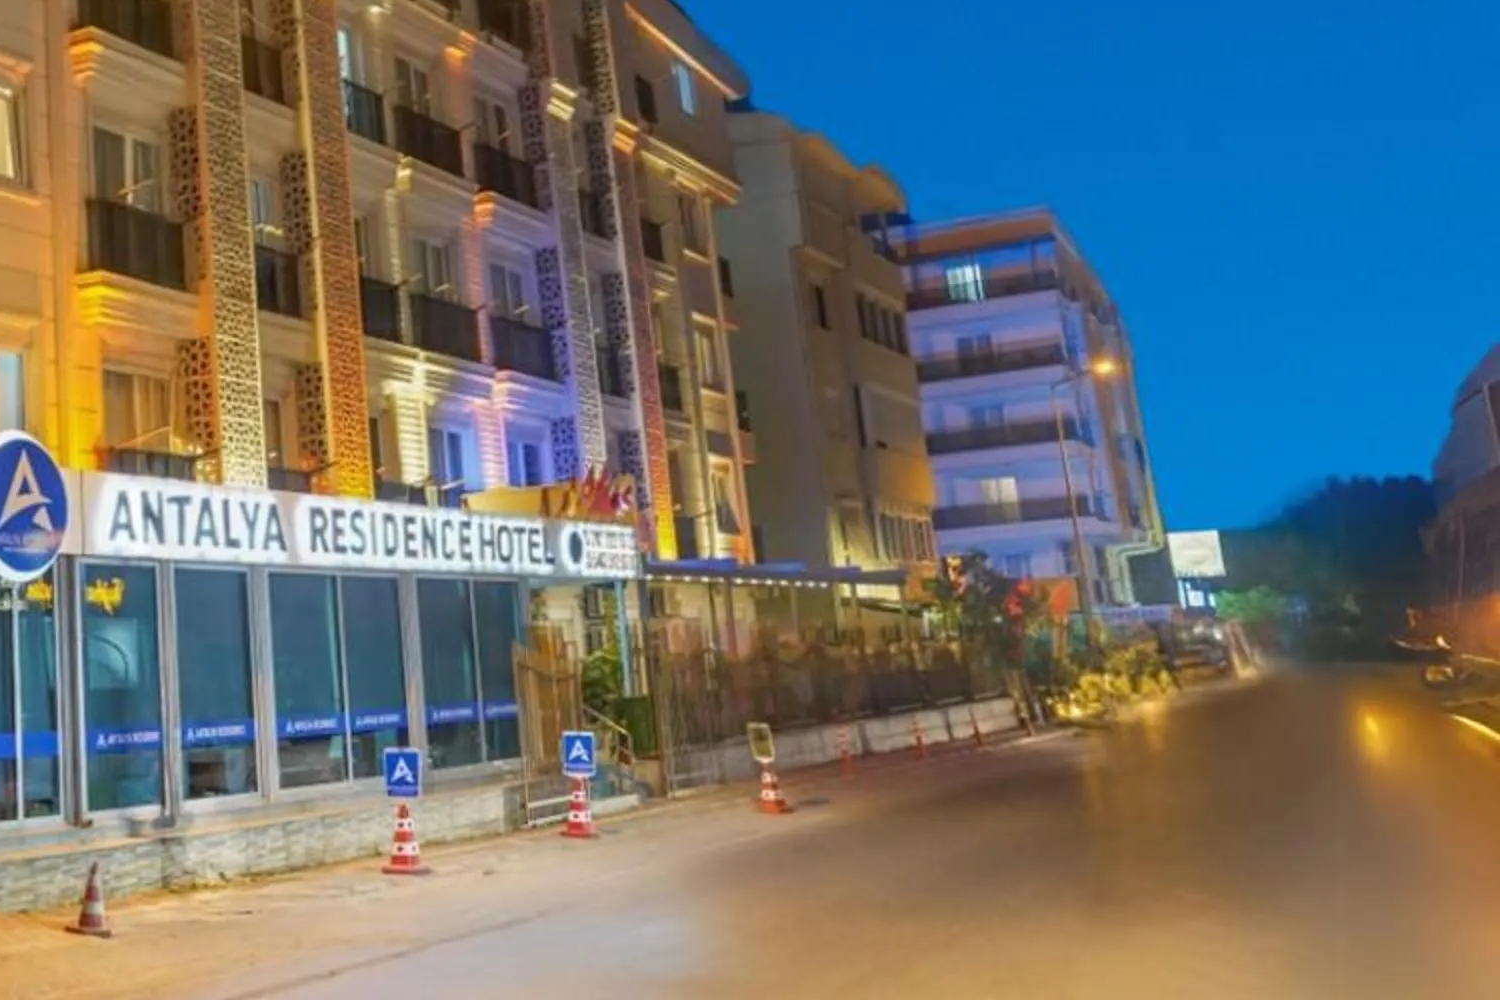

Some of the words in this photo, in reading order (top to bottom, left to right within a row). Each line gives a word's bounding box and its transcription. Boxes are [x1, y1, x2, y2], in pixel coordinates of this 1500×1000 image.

[109, 490, 287, 552] ANTALYA
[309, 507, 473, 561] RESIDENCE
[478, 522, 555, 565] HOTEL
